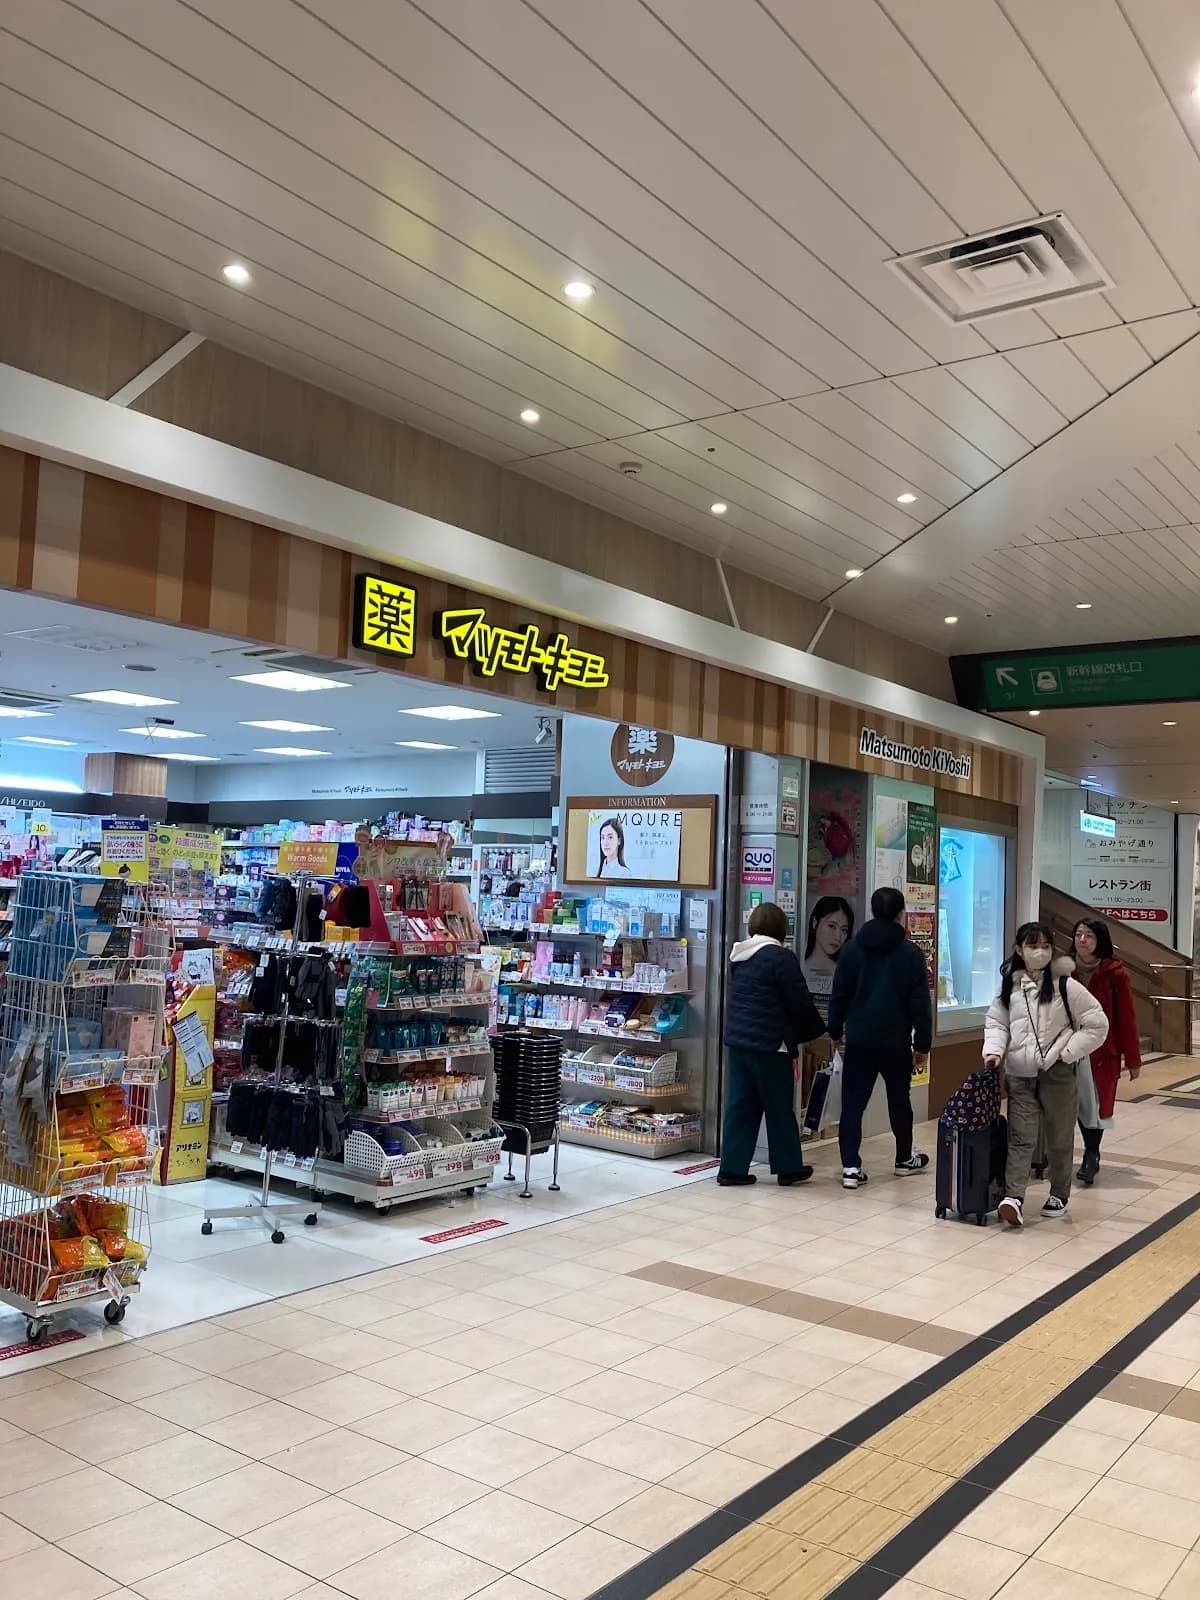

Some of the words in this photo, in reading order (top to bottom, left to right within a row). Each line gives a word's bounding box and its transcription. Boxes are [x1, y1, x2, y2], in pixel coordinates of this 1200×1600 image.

[367, 583, 413, 650] 薬
[442, 609, 609, 691] マツモトキヨシ
[860, 730, 931, 768] Matsumoto
[932, 748, 971, 778] KiYoshi
[616, 758, 666, 773] マツモトキヨシ
[0, 796, 46, 808] SHISEIDO
[608, 796, 666, 808] INFORMATION
[616, 811, 683, 828] MQURE
[1099, 839, 1155, 848] おみやげ通り
[744, 852, 772, 866] QUO
[1088, 879, 1152, 892] レストラン街
[176, 1141, 202, 1152] アリナミン
